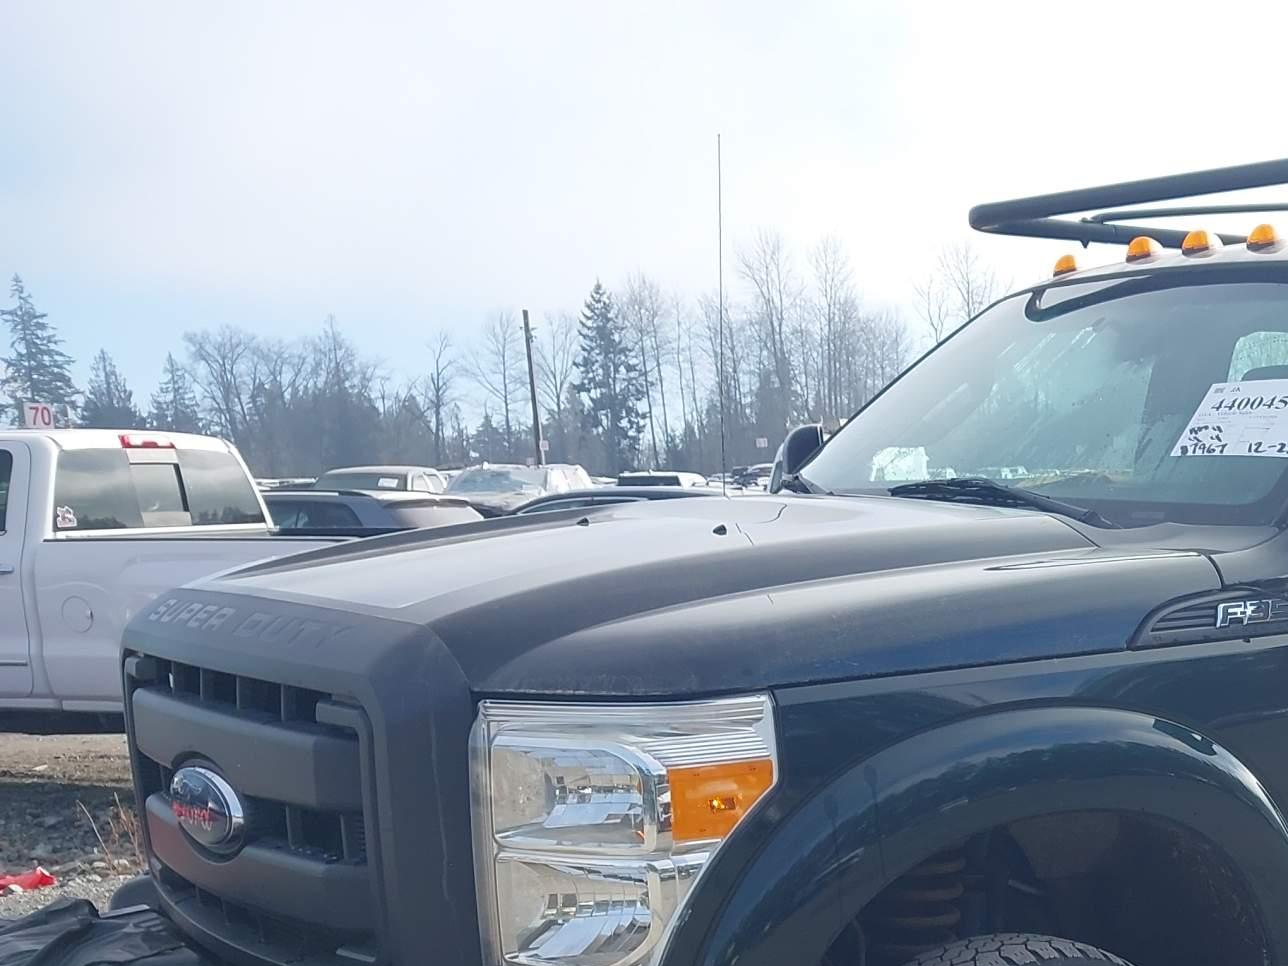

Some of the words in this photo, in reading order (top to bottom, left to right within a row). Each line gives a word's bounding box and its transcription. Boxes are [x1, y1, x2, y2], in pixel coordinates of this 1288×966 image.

[28, 406, 52, 426] 70
[149, 599, 237, 631] SUPER
[231, 611, 354, 649] DUTY
